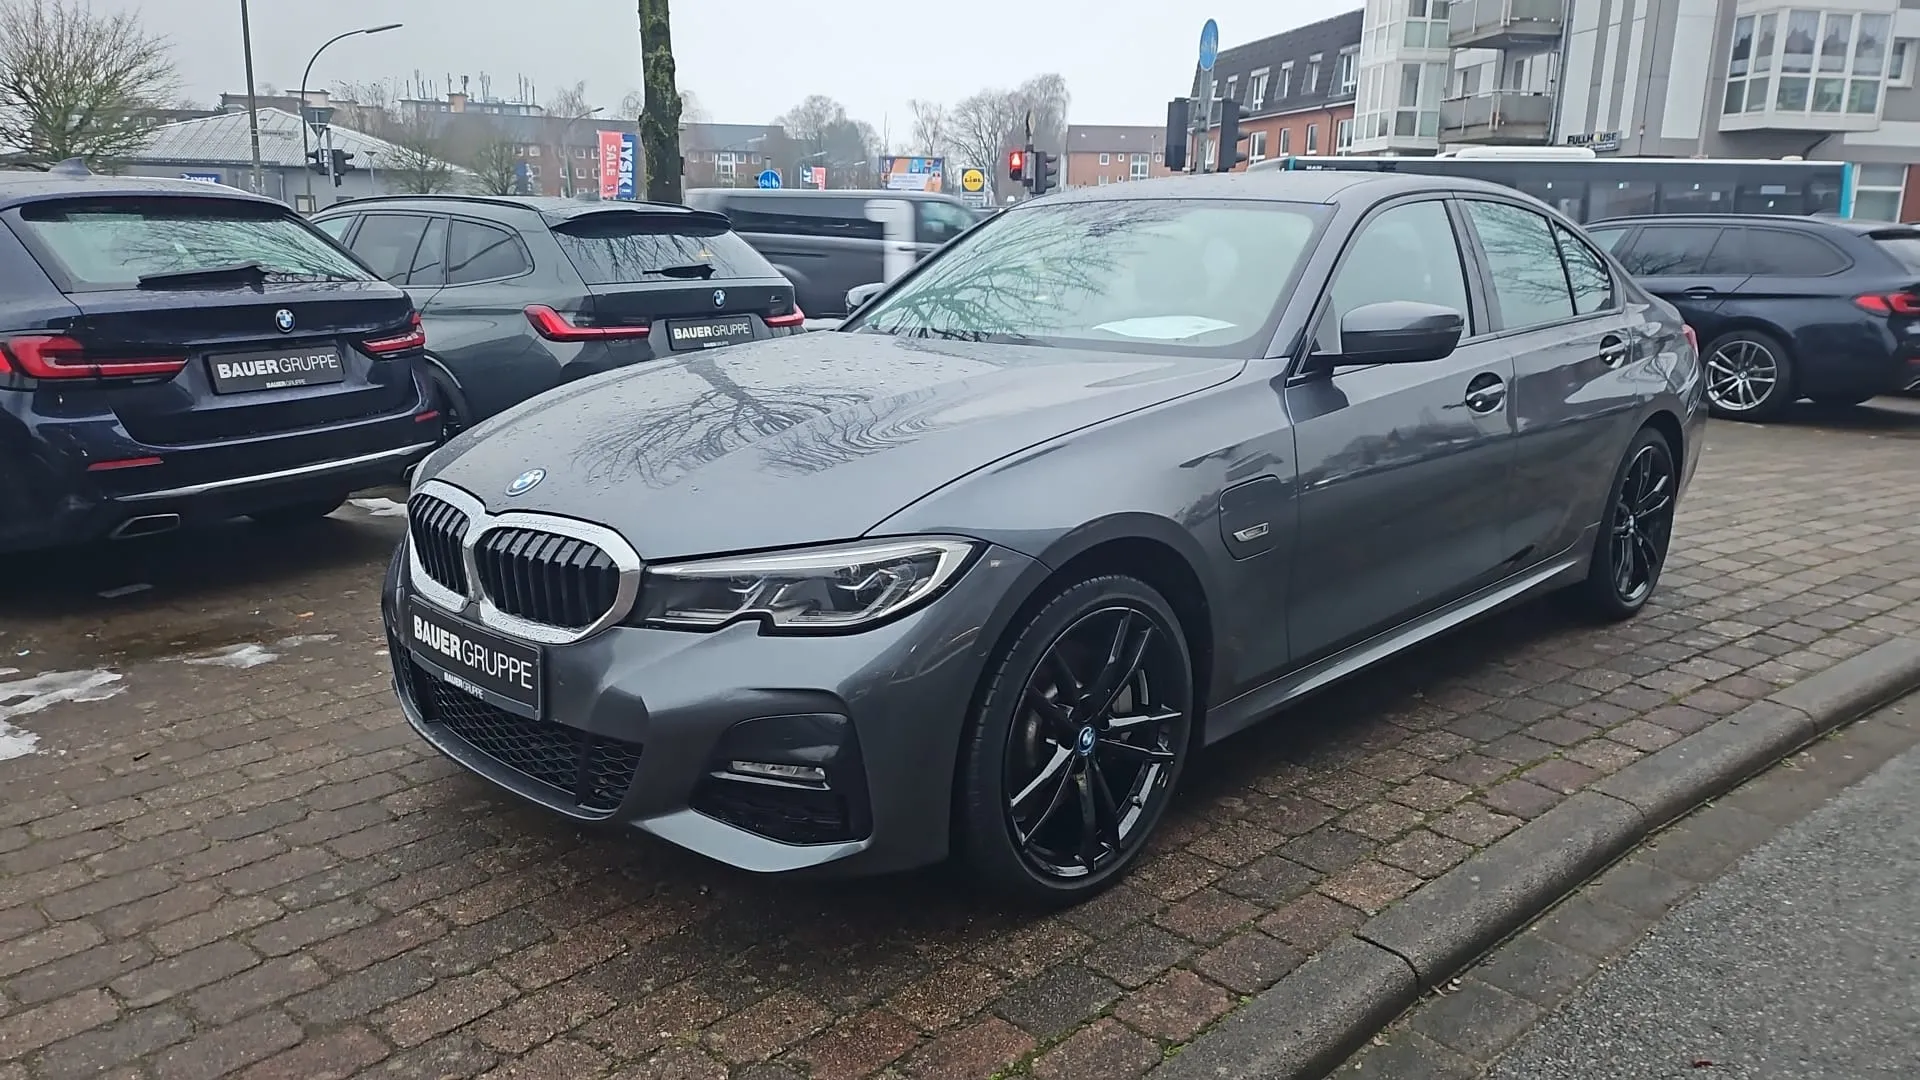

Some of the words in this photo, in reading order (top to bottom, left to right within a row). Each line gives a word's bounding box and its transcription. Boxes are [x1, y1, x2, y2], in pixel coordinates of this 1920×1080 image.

[606, 144, 617, 176] SALE
[619, 142, 633, 187] JYSK
[674, 323, 751, 340] BAUERGRUPPE
[217, 354, 338, 379] BAUERGRUPPE
[413, 614, 533, 690] BAUERGRUPPE
